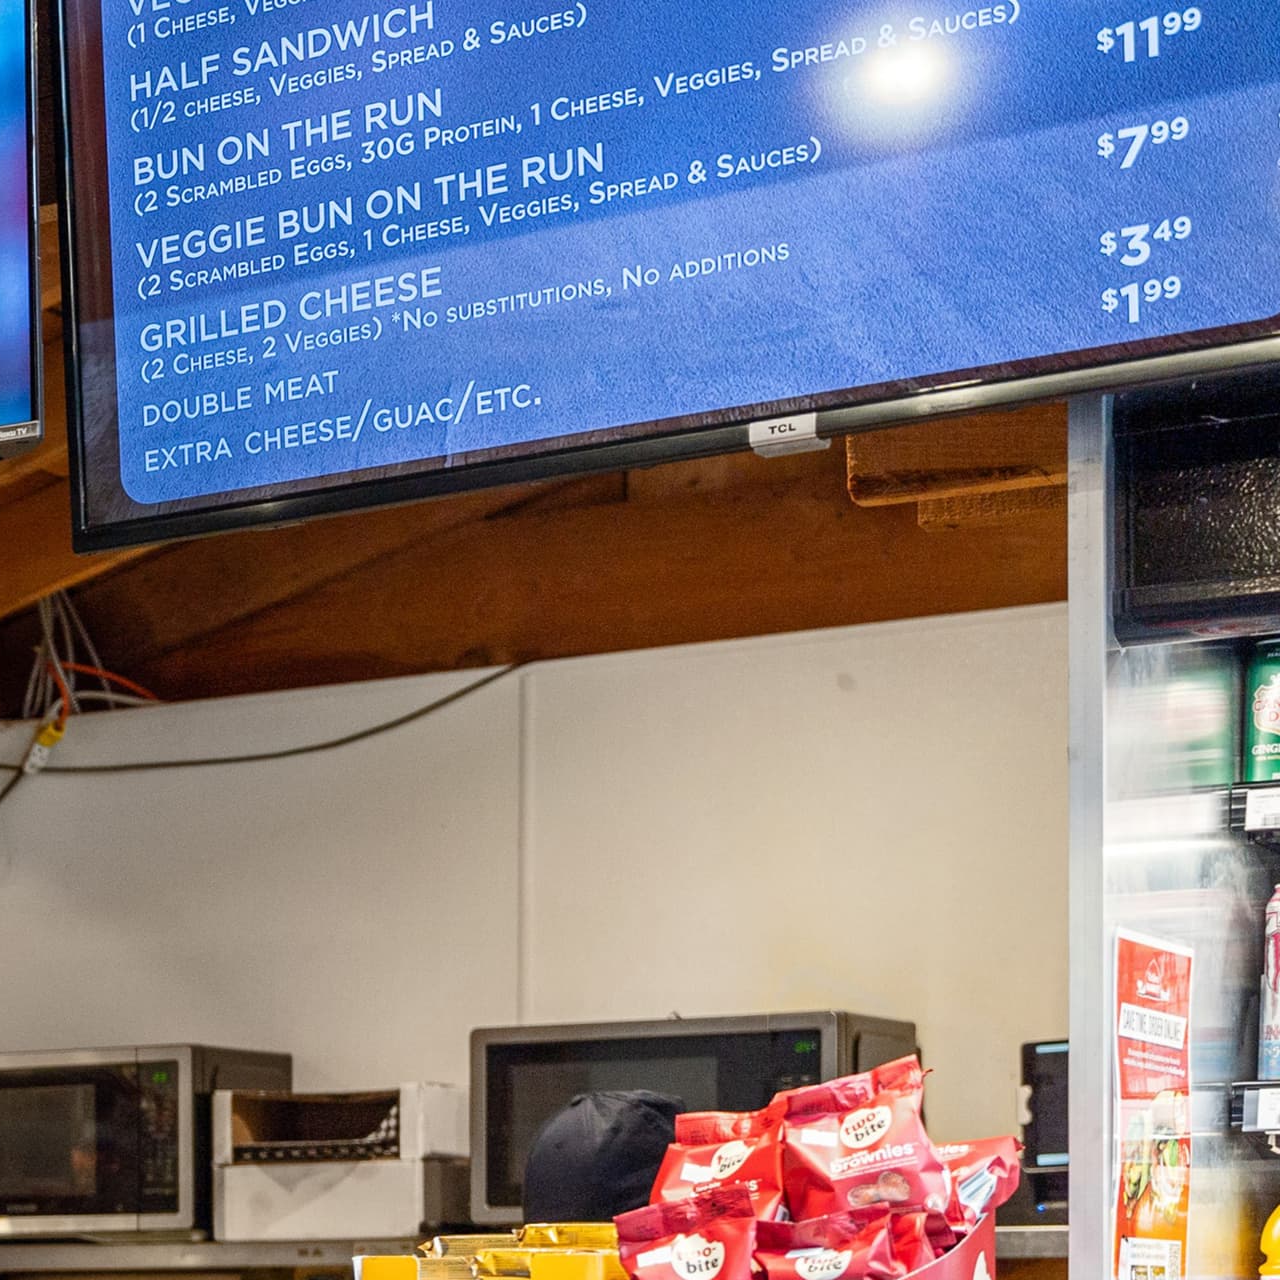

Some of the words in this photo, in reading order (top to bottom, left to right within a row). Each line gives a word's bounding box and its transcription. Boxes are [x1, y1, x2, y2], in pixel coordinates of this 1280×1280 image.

[129, 54, 222, 103] HALF
[232, 1, 436, 78] SANDWICH
[133, 145, 207, 186] BUN
[216, 129, 271, 166] ON
[281, 109, 354, 153] THE
[364, 88, 444, 134] RUN
[135, 214, 268, 270] VEGGIE
[277, 196, 355, 238] BUN
[364, 181, 422, 222] ON
[433, 162, 509, 206] THE
[520, 142, 606, 190] RUN
[140, 299, 288, 354] GRILLED
[298, 266, 444, 322] CHEESE
[140, 355, 166, 384] (2
[171, 334, 255, 374] CHEESE,
[260, 335, 278, 360] 2
[283, 314, 385, 355] VEGGIES)
[621, 265, 662, 288] NO
[669, 243, 792, 281] ADDITIONS
[142, 386, 254, 428] DOUBLE
[264, 371, 341, 405] MEAT
[144, 439, 234, 473] EXTRA
[244, 380, 543, 455] CHEESE/GUAC/ETC.
[767, 420, 798, 435] TCL
[831, 1143, 915, 1173] brownies
